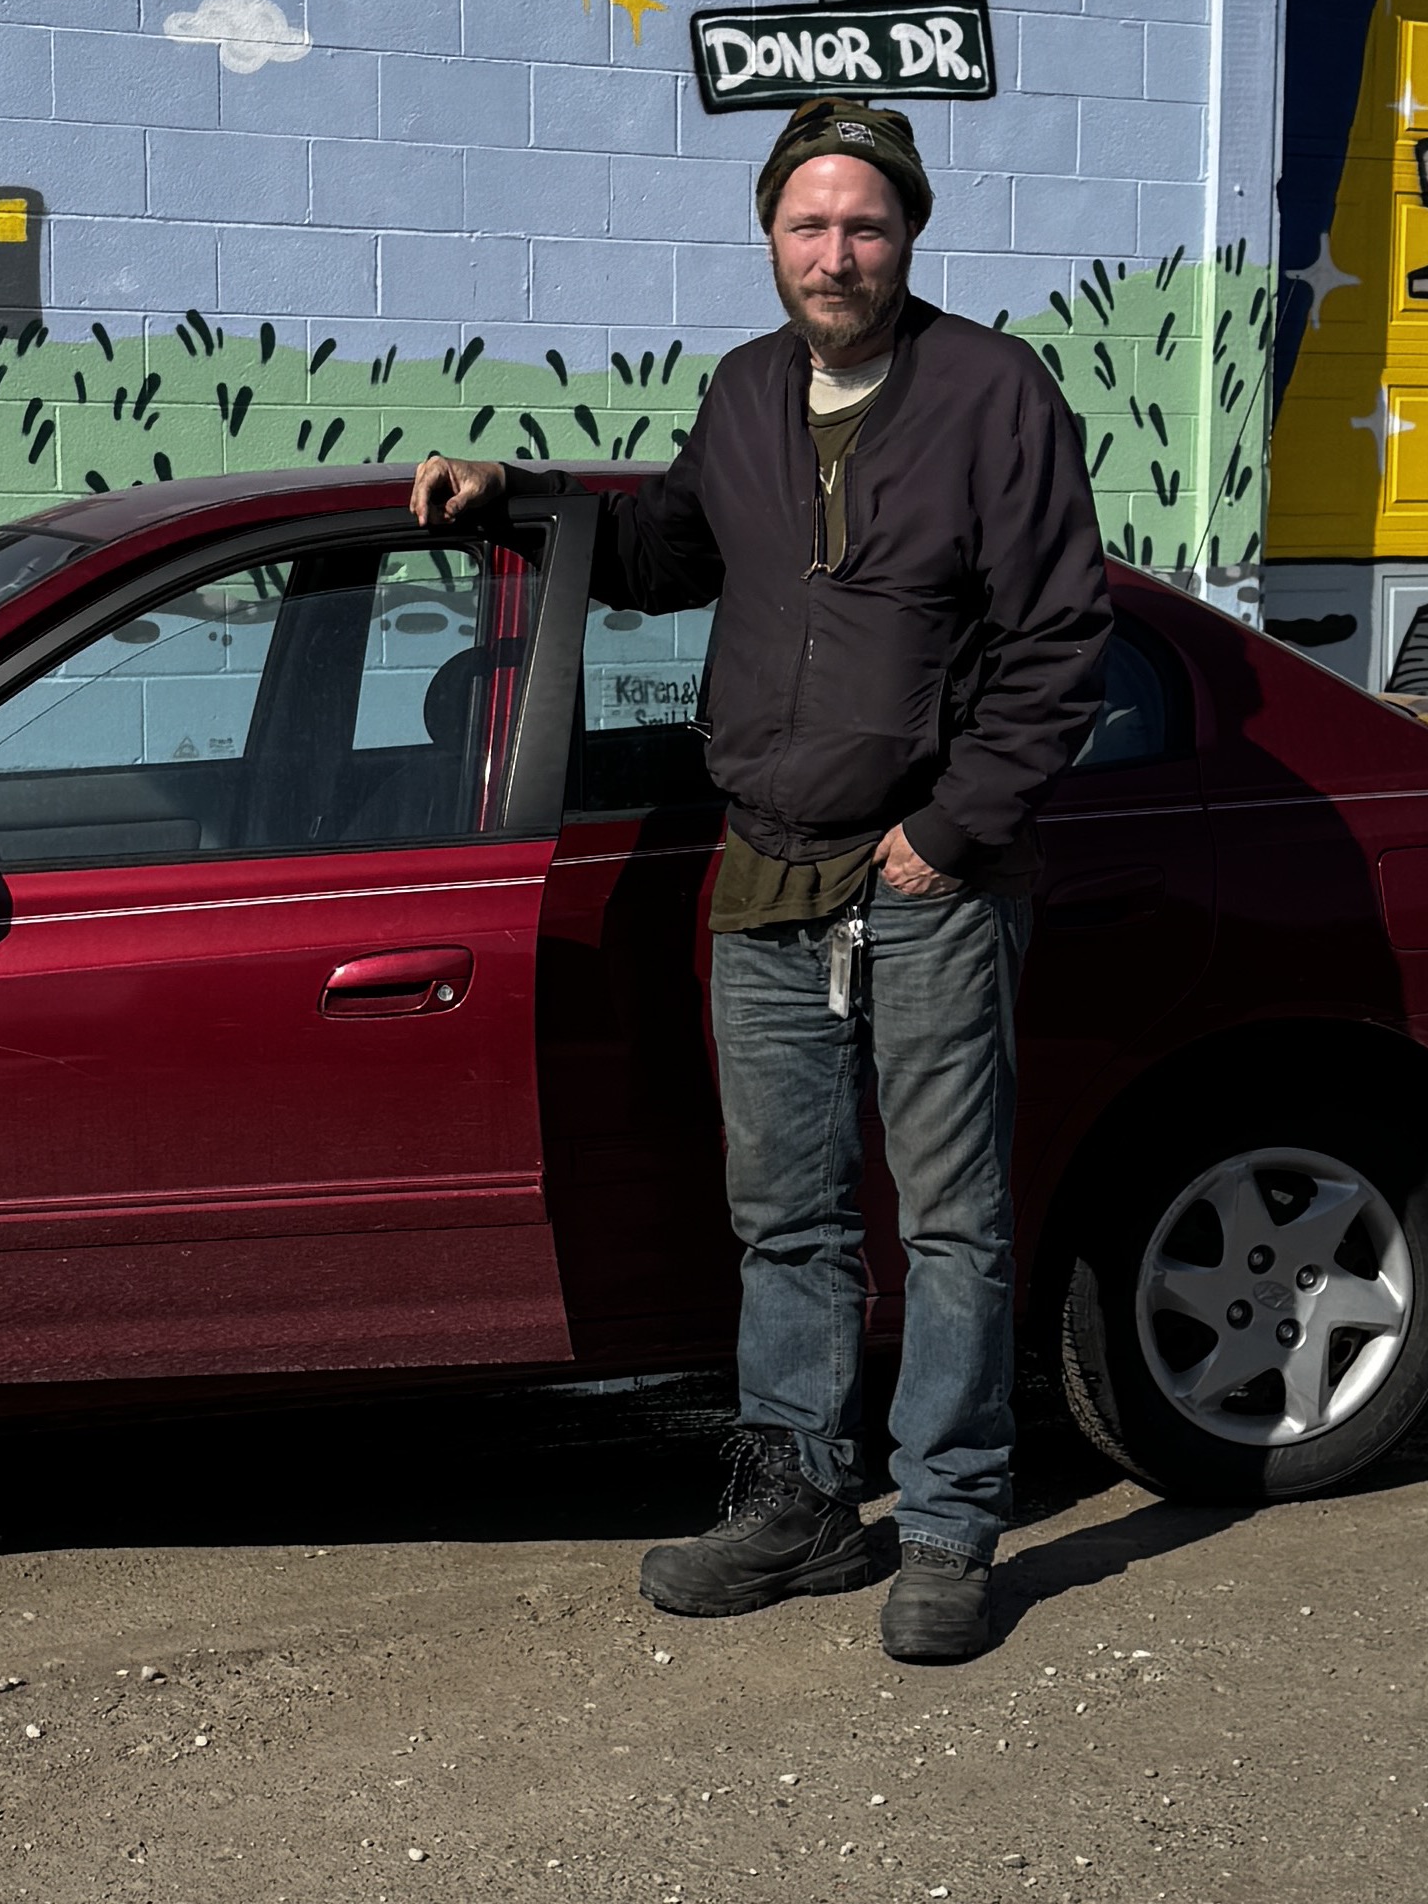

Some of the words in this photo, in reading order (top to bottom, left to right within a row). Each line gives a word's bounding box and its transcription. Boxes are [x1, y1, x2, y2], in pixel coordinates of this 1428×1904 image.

[705, 26, 882, 91] DONOR
[889, 16, 982, 81] DR.
[615, 675, 680, 705] Karen
